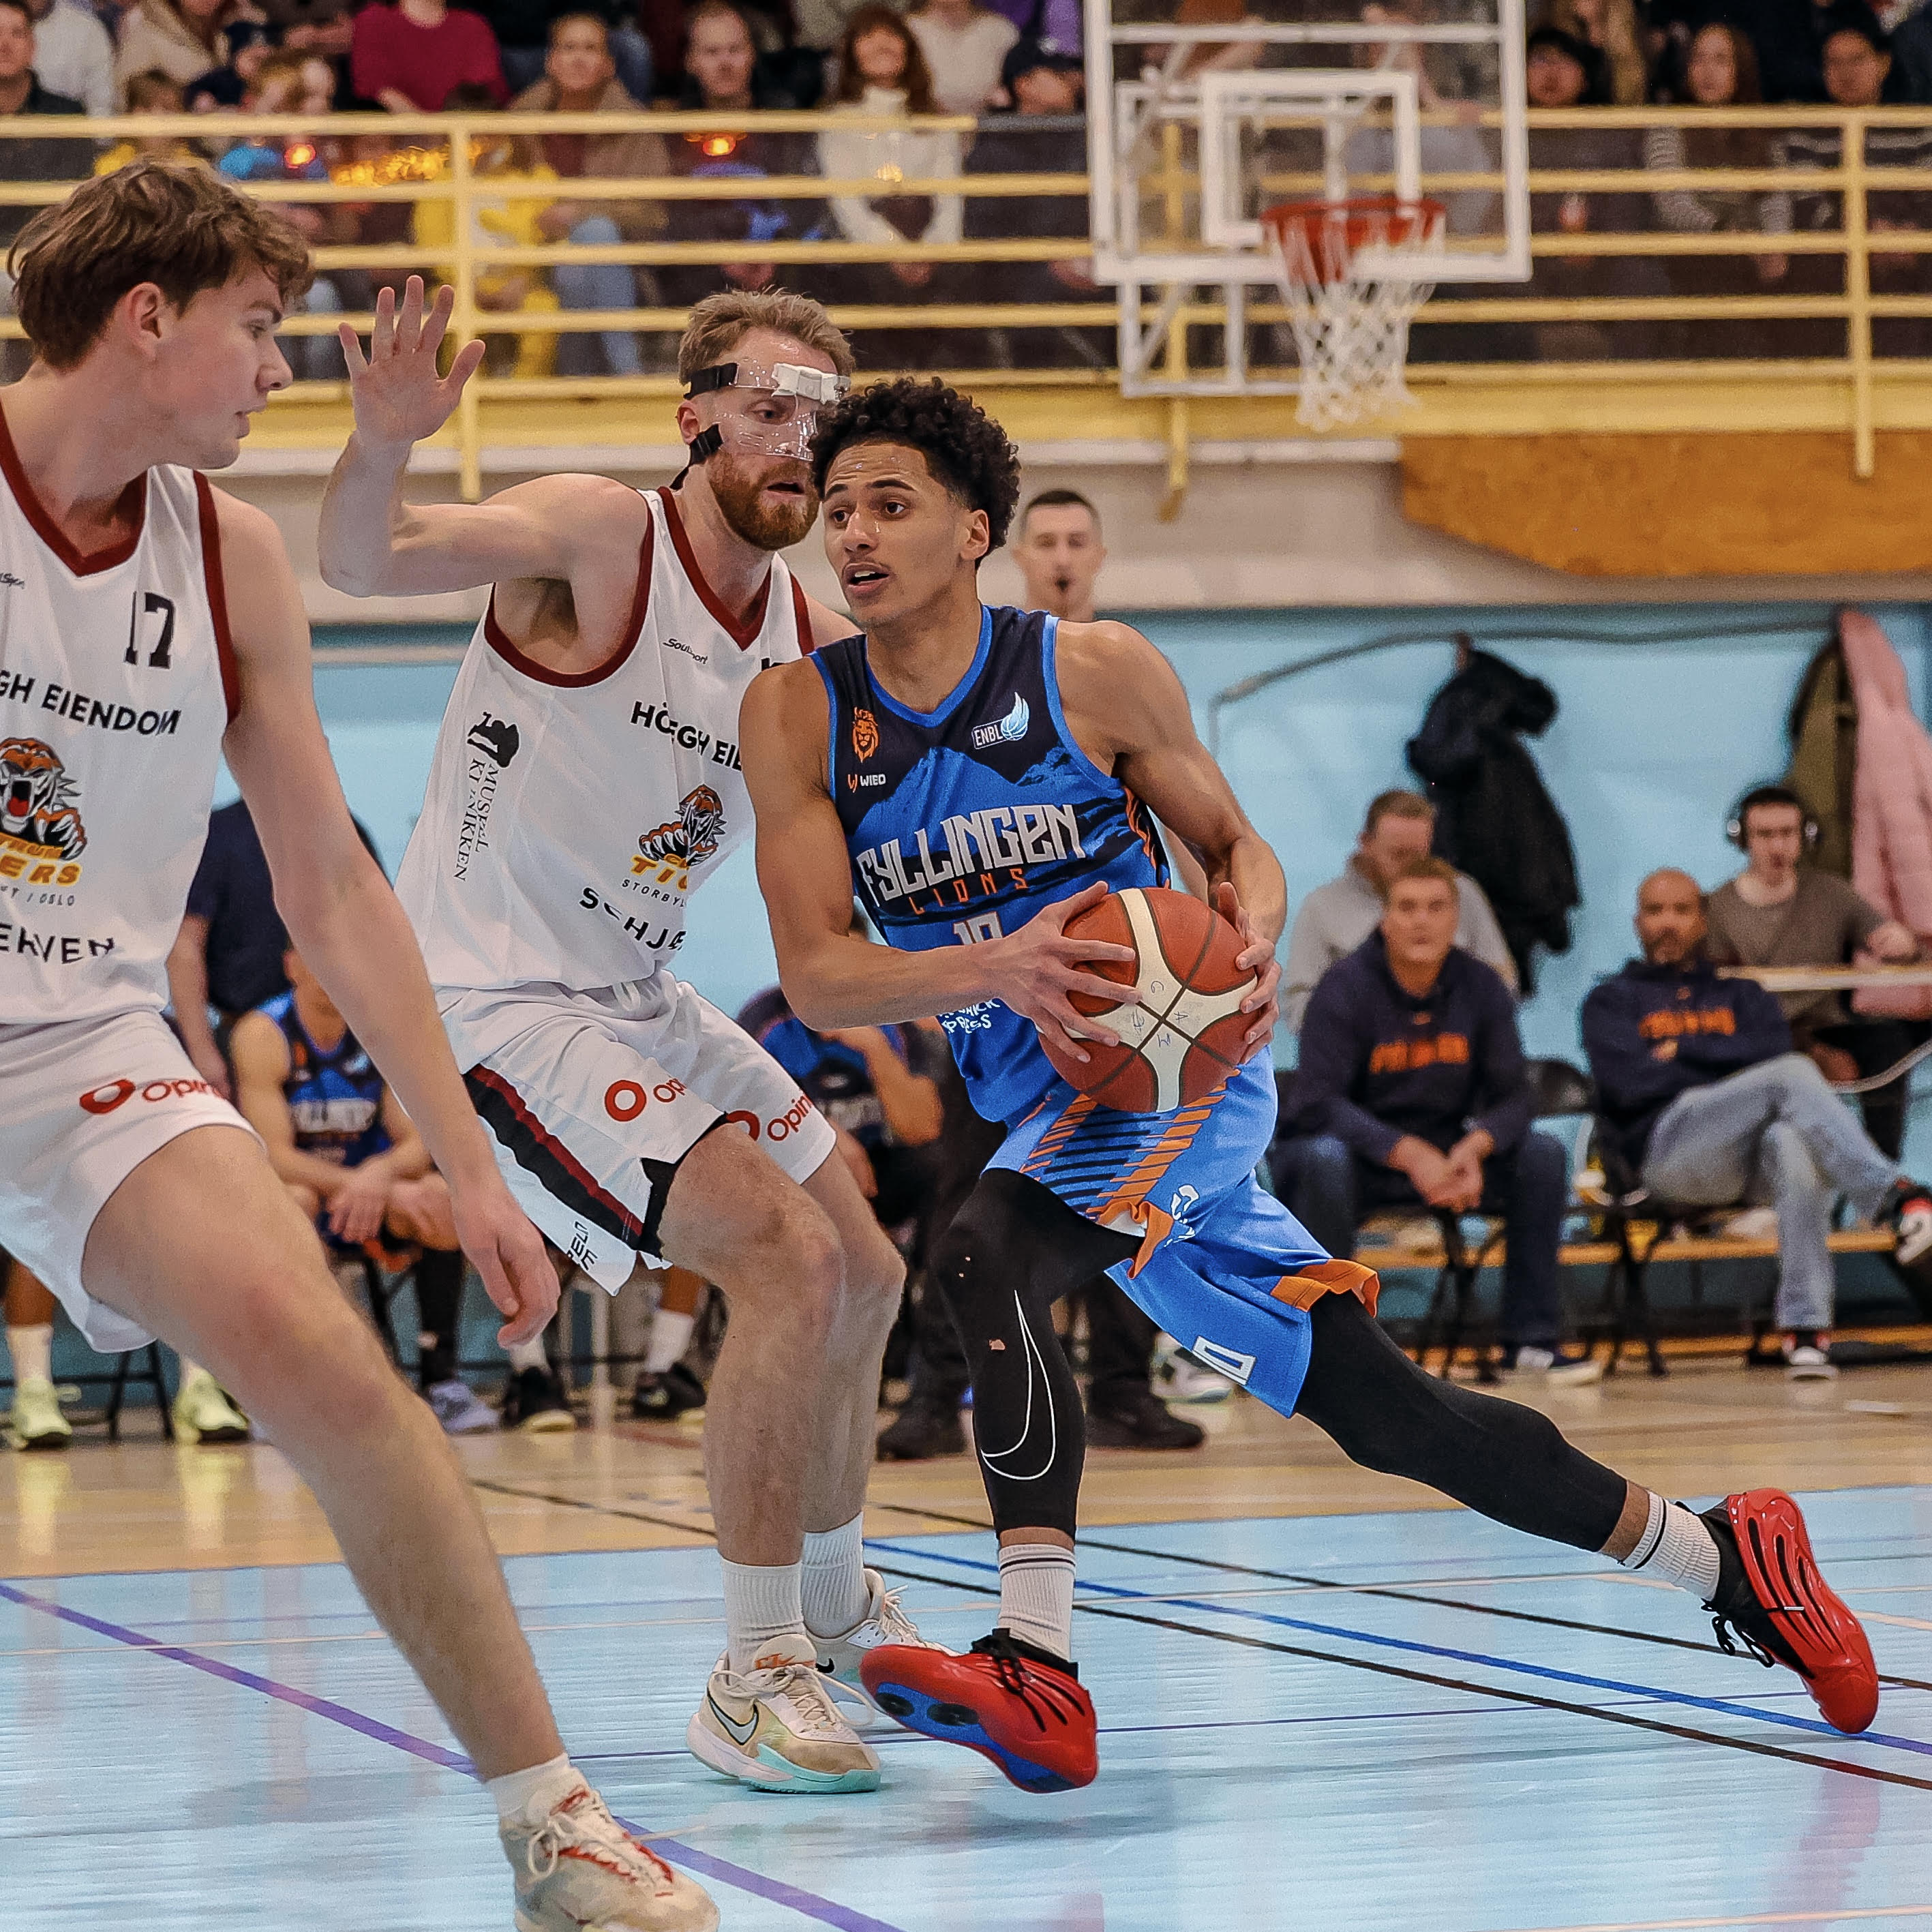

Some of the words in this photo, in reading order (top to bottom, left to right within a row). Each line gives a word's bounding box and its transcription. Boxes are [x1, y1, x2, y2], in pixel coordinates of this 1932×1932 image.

[123, 590, 175, 669] 17
[975, 726, 1003, 746] ENBL
[859, 773, 886, 787] WIED
[856, 804, 1087, 907] FYLLINGEN
[908, 868, 1029, 916] LIONS
